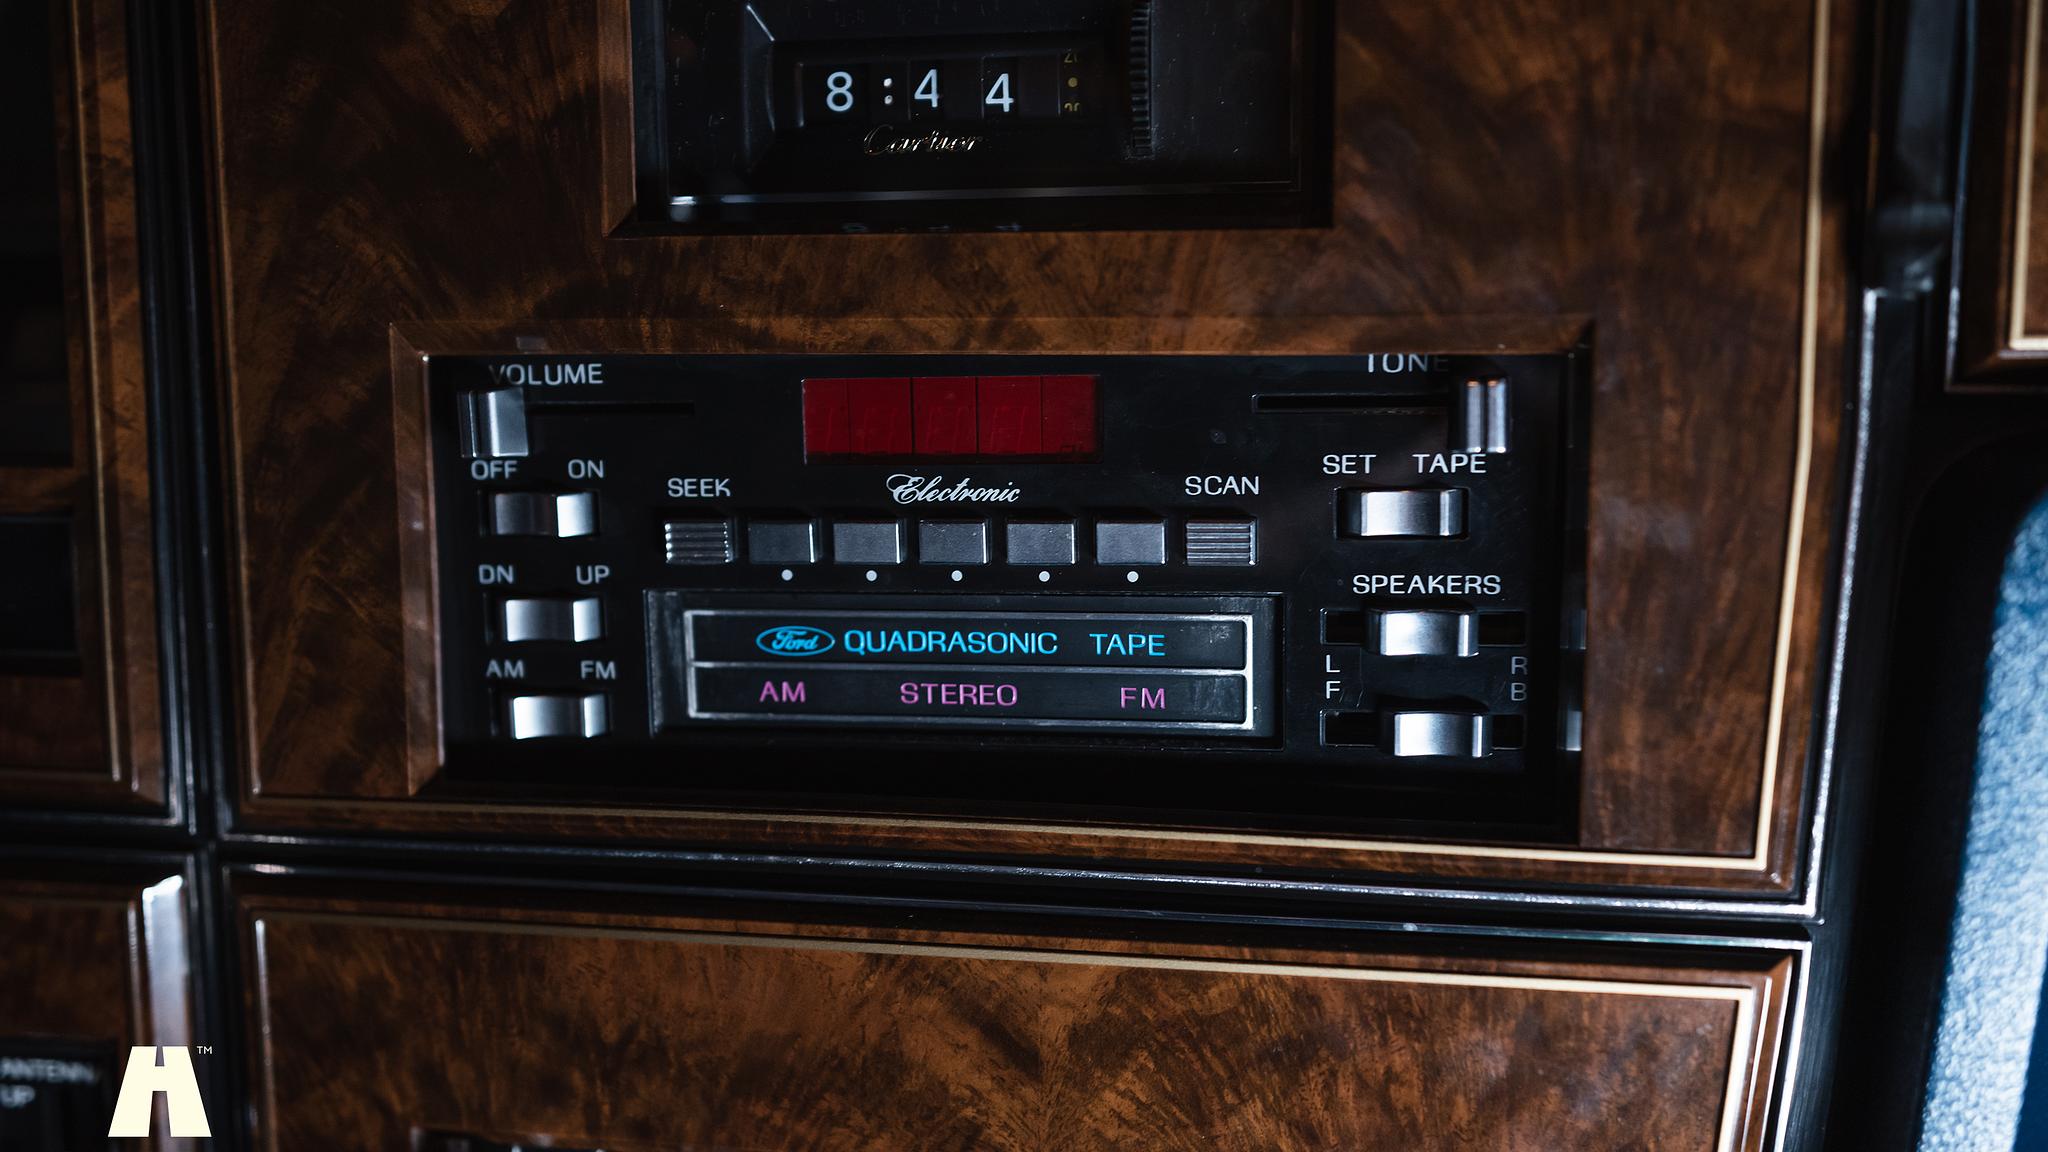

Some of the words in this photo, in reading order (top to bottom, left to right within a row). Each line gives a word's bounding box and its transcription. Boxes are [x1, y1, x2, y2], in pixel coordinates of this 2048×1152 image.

[1367, 353, 1450, 374] TONE
[488, 363, 604, 386] VOLUME
[470, 459, 518, 480] OFF
[567, 458, 605, 480] ON
[1322, 454, 1377, 475] SET
[1411, 453, 1488, 474] TAPE
[667, 477, 731, 498] SEEK
[886, 473, 1021, 505] Electronic
[1184, 475, 1260, 496] SCAN
[478, 564, 515, 585] DN
[575, 564, 611, 585] UP
[1352, 574, 1502, 596] SPEAKERS
[843, 629, 1058, 656] QUADRASONIC
[1088, 632, 1166, 657] TAPE
[485, 659, 525, 679] AM
[580, 660, 617, 680] FM
[1325, 654, 1341, 673] L
[1511, 656, 1528, 674] R
[759, 680, 806, 703] AM
[899, 682, 1018, 707] STEREO
[1119, 686, 1166, 710] FM
[1325, 680, 1341, 700] F
[1511, 682, 1528, 702] B
[0, 1058, 98, 1083] ANTENN
